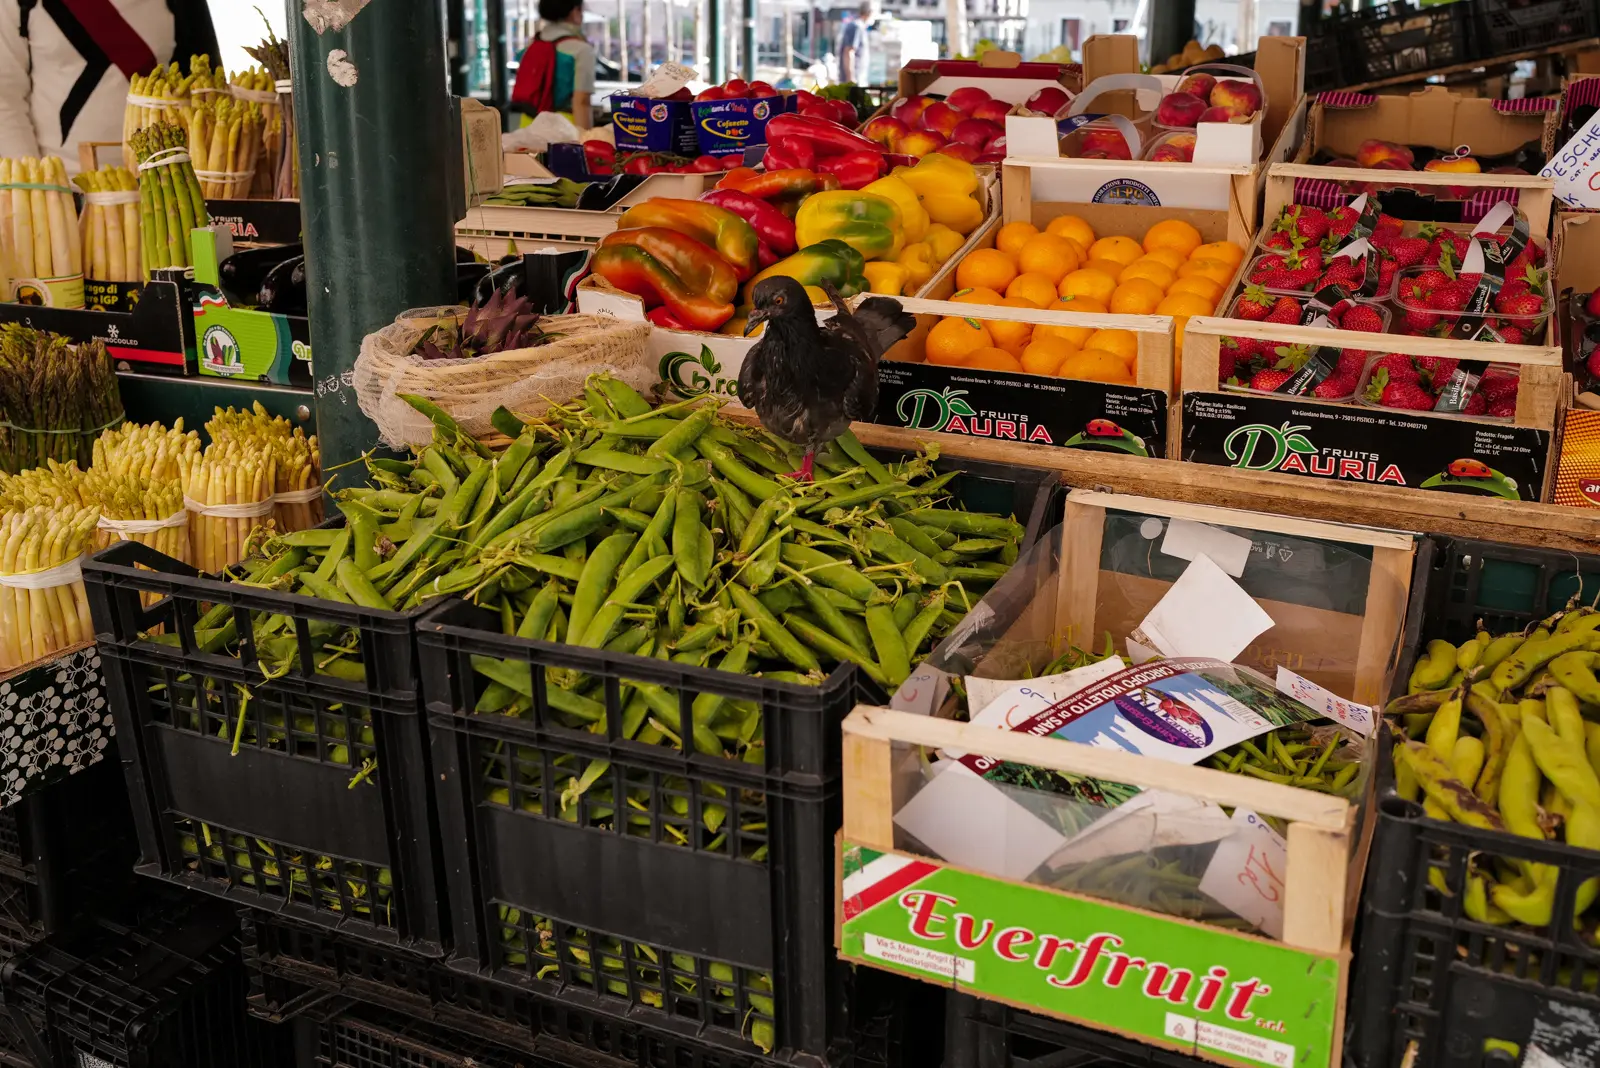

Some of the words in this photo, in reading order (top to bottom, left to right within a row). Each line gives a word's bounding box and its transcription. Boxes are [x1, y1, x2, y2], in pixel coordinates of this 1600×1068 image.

[1122, 179, 1150, 194] PRODOTTI
[107, 283, 118, 294] di
[100, 294, 119, 305] IGP
[1287, 367, 1313, 395] Basilicata
[1449, 371, 1467, 405] Basilicata
[1123, 394, 1139, 402] Fragole
[1226, 403, 1247, 411] Basilicata
[980, 410, 1029, 422] FRUITS
[1299, 410, 1320, 418] Giordano
[1319, 412, 1335, 420] Bruno,
[1341, 414, 1356, 422] 75015
[1356, 416, 1375, 424] PISTICCI
[1389, 419, 1398, 427] Tel.
[1406, 422, 1428, 430] 0403710
[1475, 430, 1497, 439] Prodotto:
[1497, 432, 1515, 441] Fragole
[1322, 447, 1380, 461] FRUITS
[1121, 664, 1174, 694] CARCIOFO
[1069, 682, 1122, 716] VIOLETTO
[1058, 709, 1070, 721] DI
[1115, 698, 1179, 744] Sant'Erasmo
[876, 937, 889, 949] Via
[889, 941, 896, 950] S.
[898, 943, 921, 957] Maria
[898, 888, 1272, 1022] Everfruit
